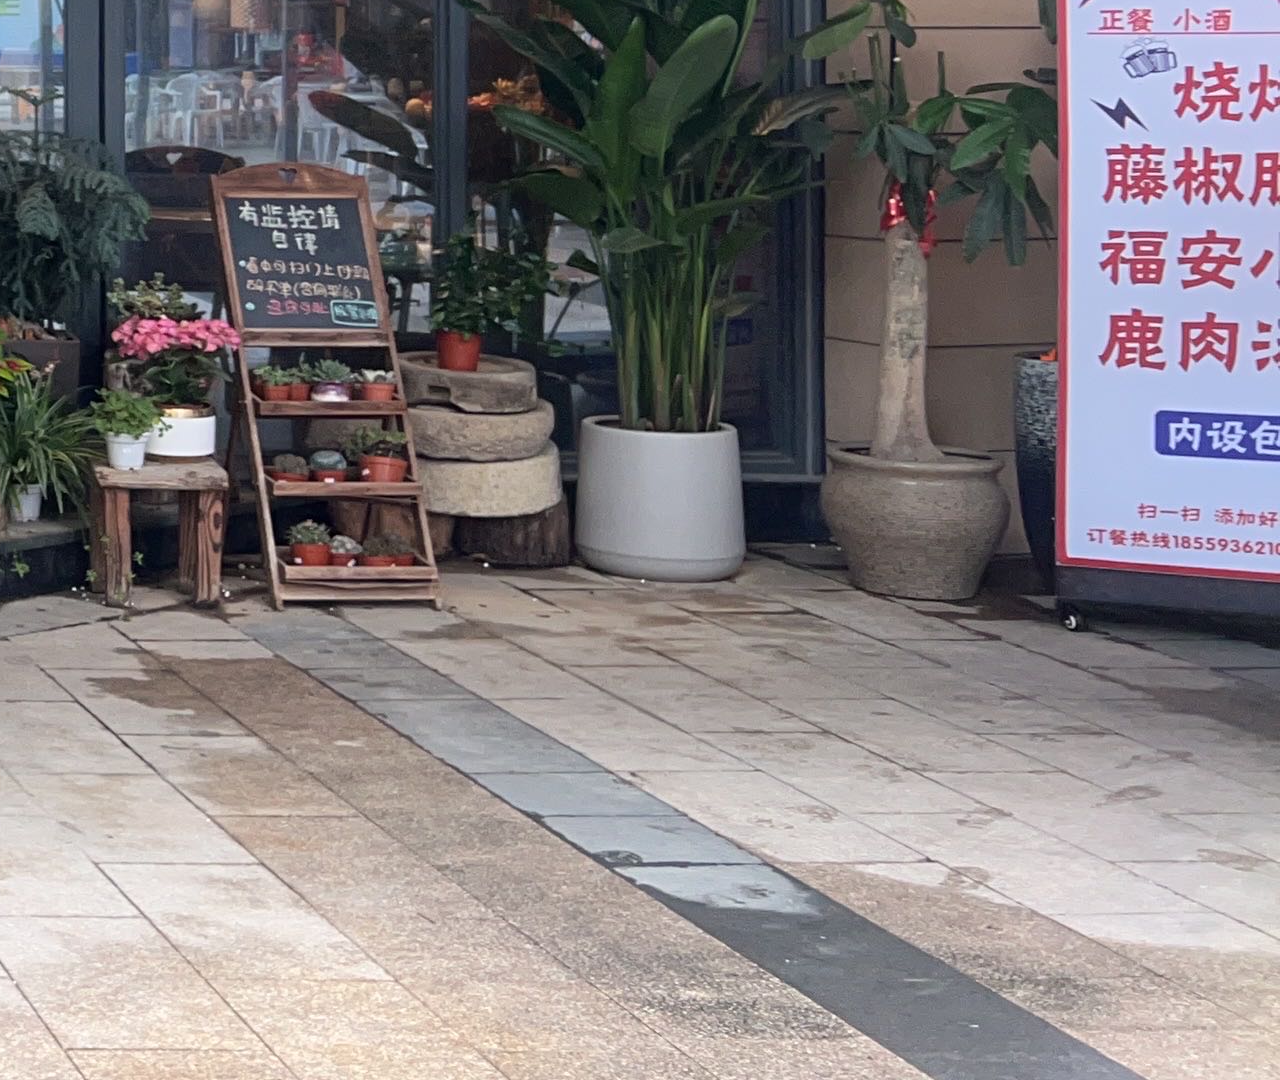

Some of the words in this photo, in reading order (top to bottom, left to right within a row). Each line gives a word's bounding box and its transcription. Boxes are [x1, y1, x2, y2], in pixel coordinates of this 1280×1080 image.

[1098, 8, 1154, 32] 正餐
[1173, 8, 1232, 32] 小酒
[238, 201, 341, 230] 有监控请
[272, 230, 319, 255] 自律
[1167, 417, 1280, 456] 内设包
[1137, 503, 1201, 522] 扫一扫
